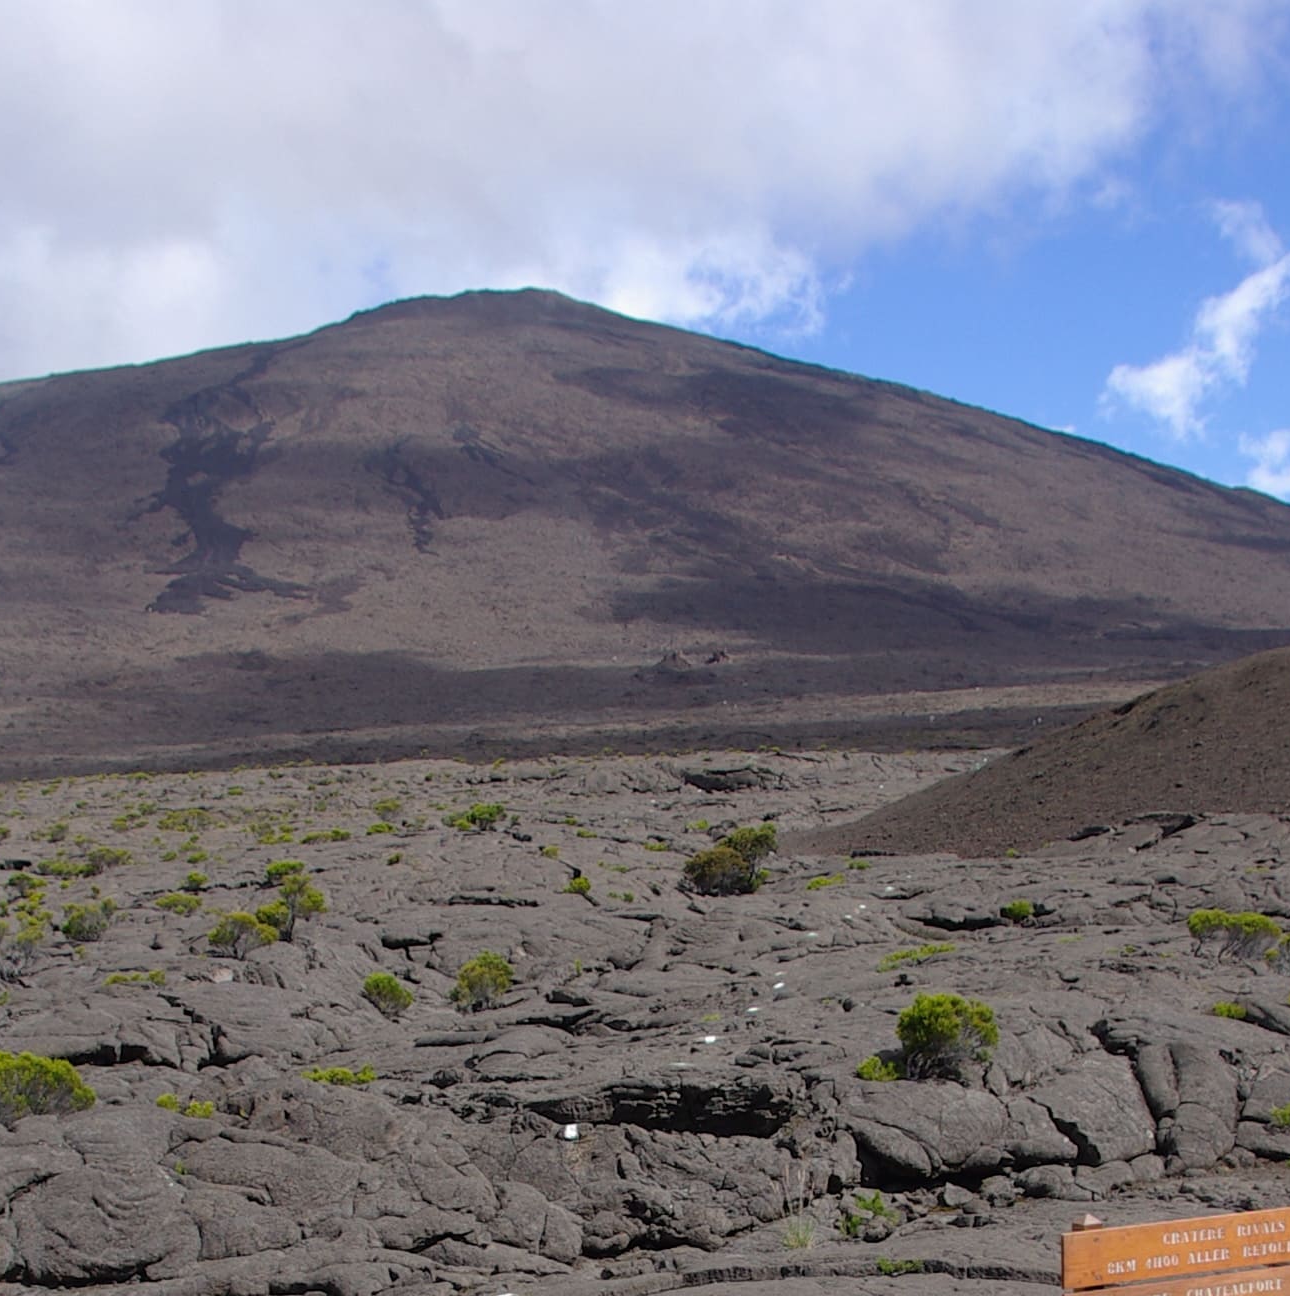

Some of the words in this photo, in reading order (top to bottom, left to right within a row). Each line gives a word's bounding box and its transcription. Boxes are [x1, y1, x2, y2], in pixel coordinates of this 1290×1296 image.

[1163, 1227, 1225, 1245] CRATERE
[1237, 1221, 1286, 1238] RIVALS
[1187, 1248, 1230, 1264] ALLER
